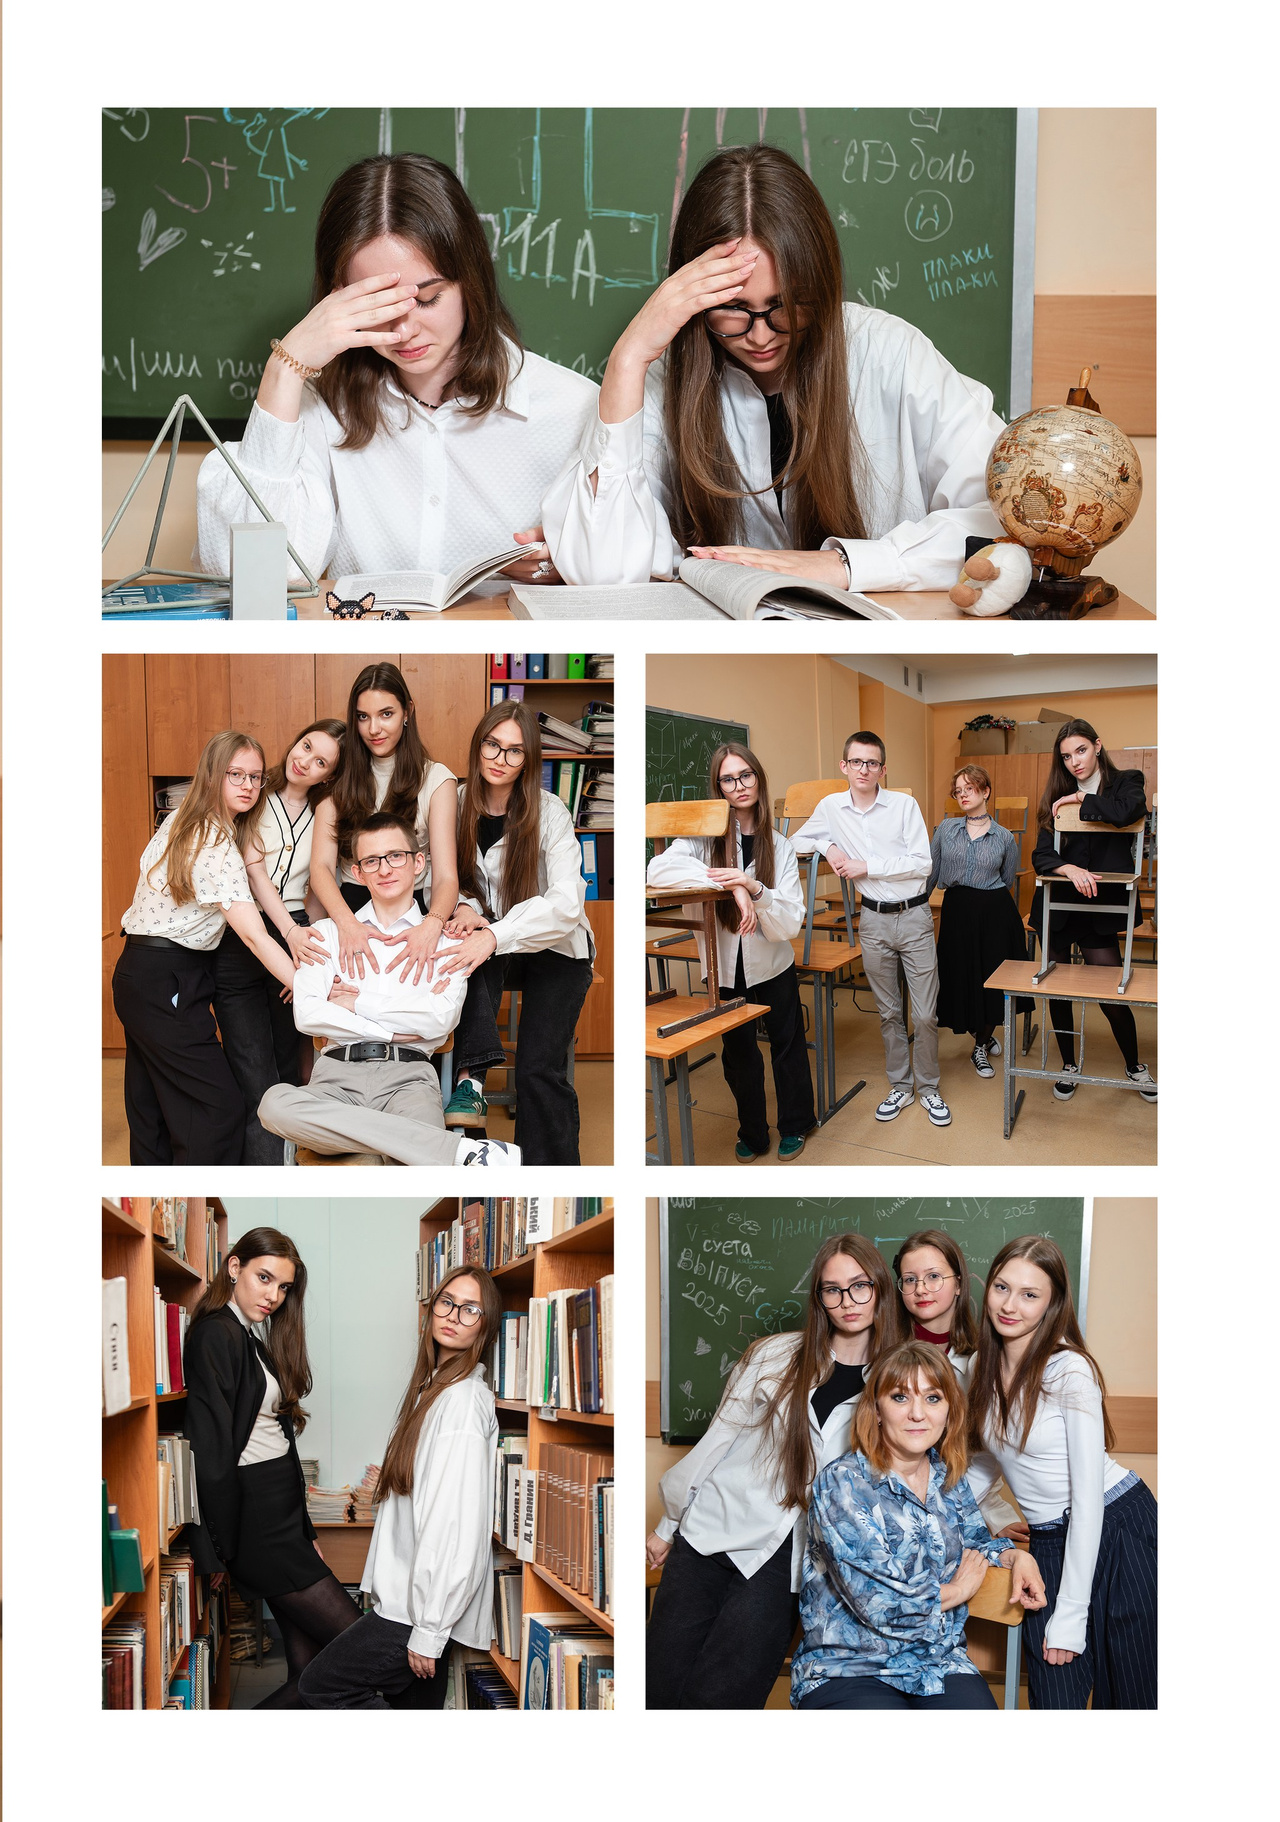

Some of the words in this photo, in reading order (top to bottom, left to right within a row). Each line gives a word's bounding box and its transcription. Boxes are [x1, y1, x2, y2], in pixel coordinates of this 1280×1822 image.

[842, 139, 901, 184] ЕГЭ
[1004, 1200, 1038, 1220] 2025
[681, 1282, 731, 1326] 2025
[524, 1479, 535, 1528] Гранин
